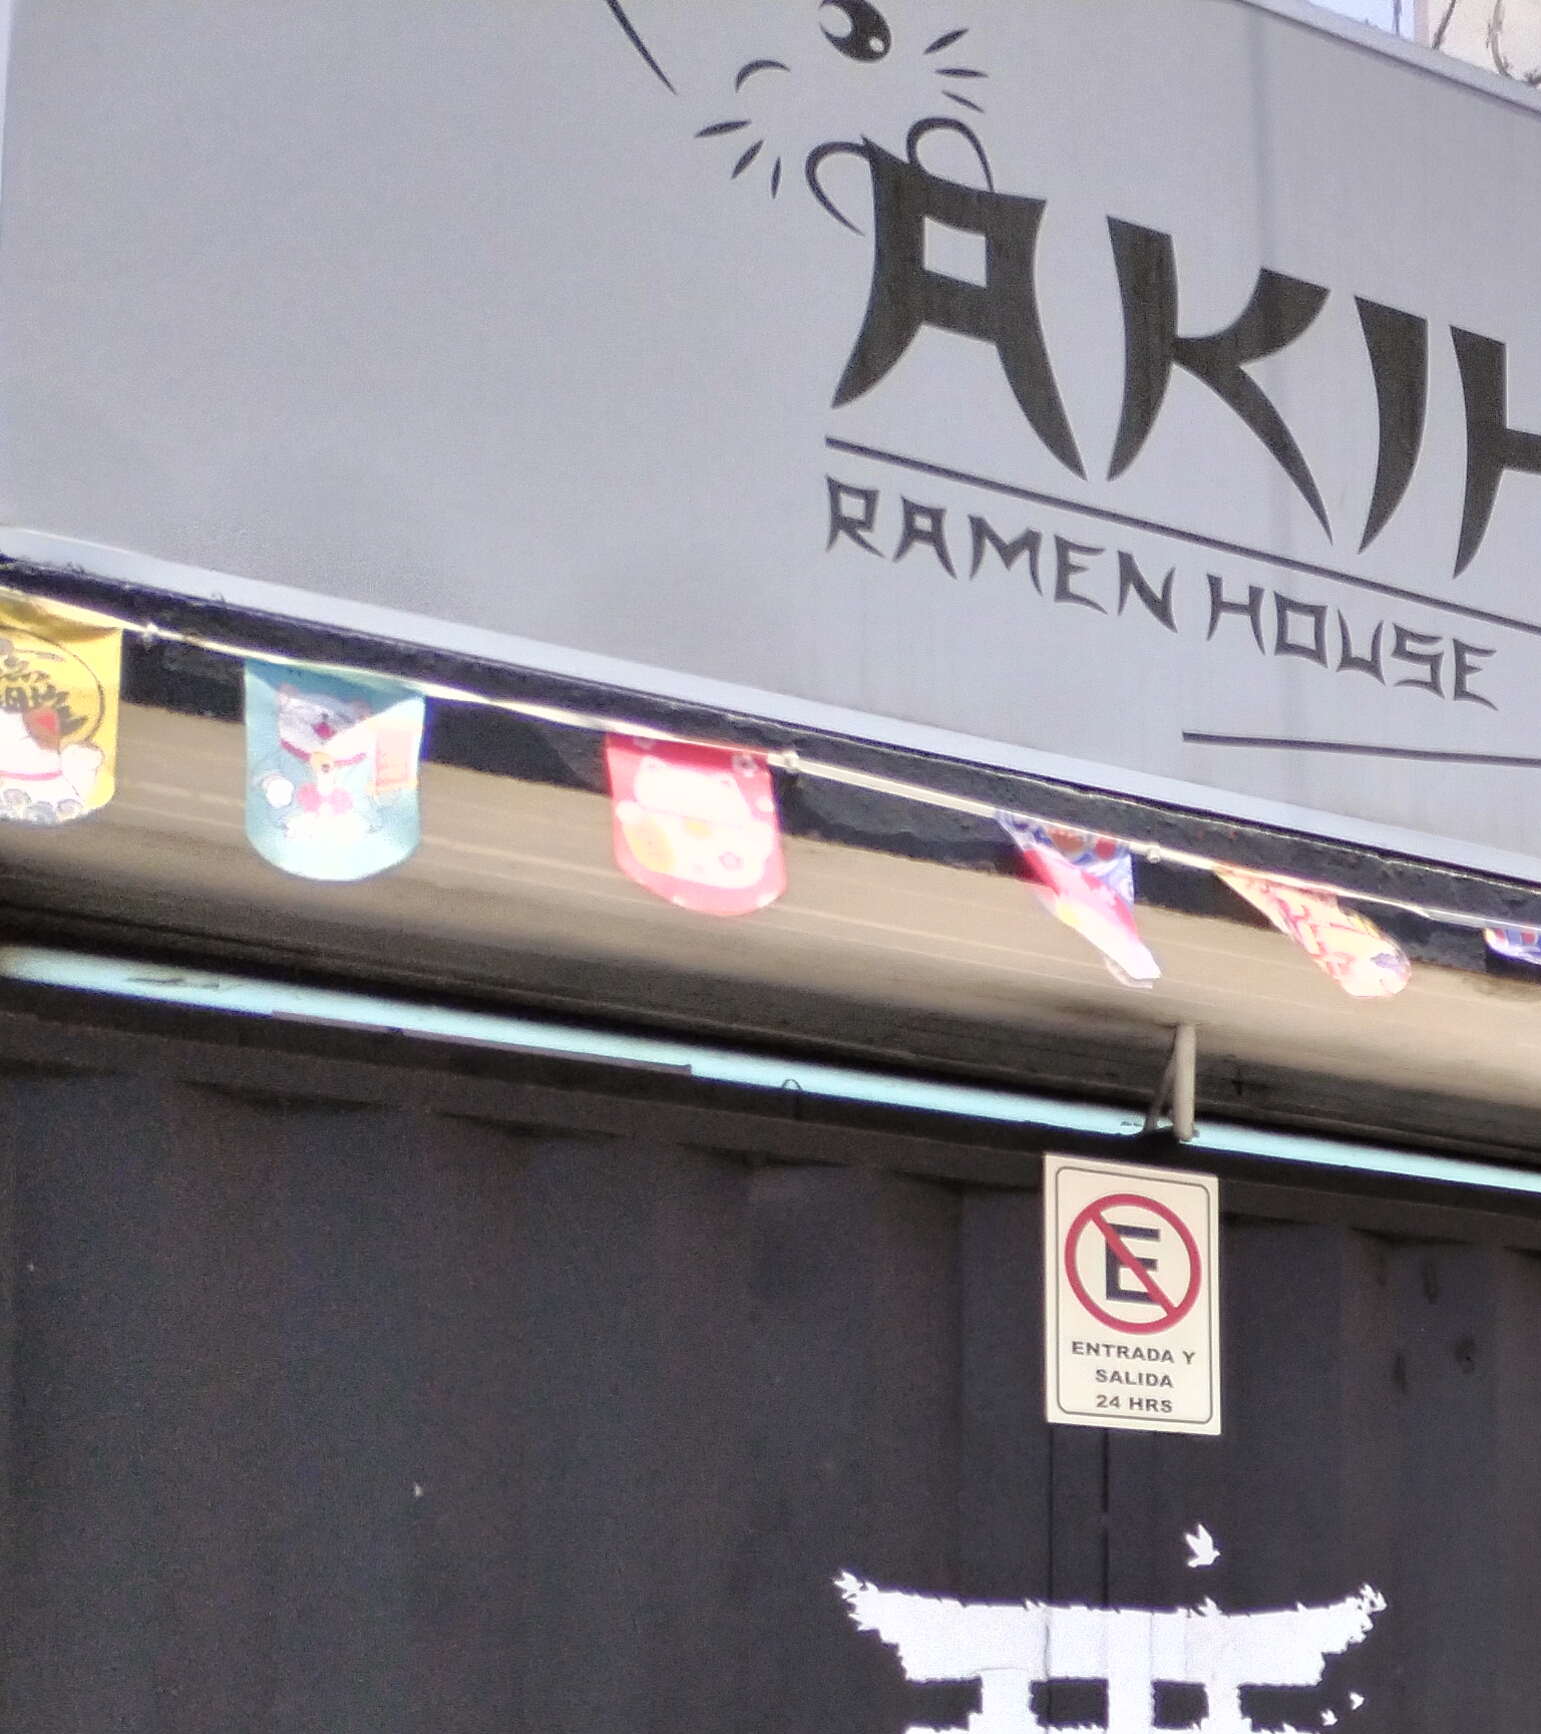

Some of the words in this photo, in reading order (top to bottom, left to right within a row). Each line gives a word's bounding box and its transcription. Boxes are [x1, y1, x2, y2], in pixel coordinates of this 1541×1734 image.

[824, 474, 1177, 633] RAMEN
[1206, 573, 1498, 711] HOUSE
[1071, 1340, 1176, 1364] ENTRADA
[1182, 1350, 1197, 1365] Y
[1095, 1368, 1175, 1389] SALIDA
[1096, 1394, 1121, 1410] 24
[1129, 1397, 1173, 1414] HRS
